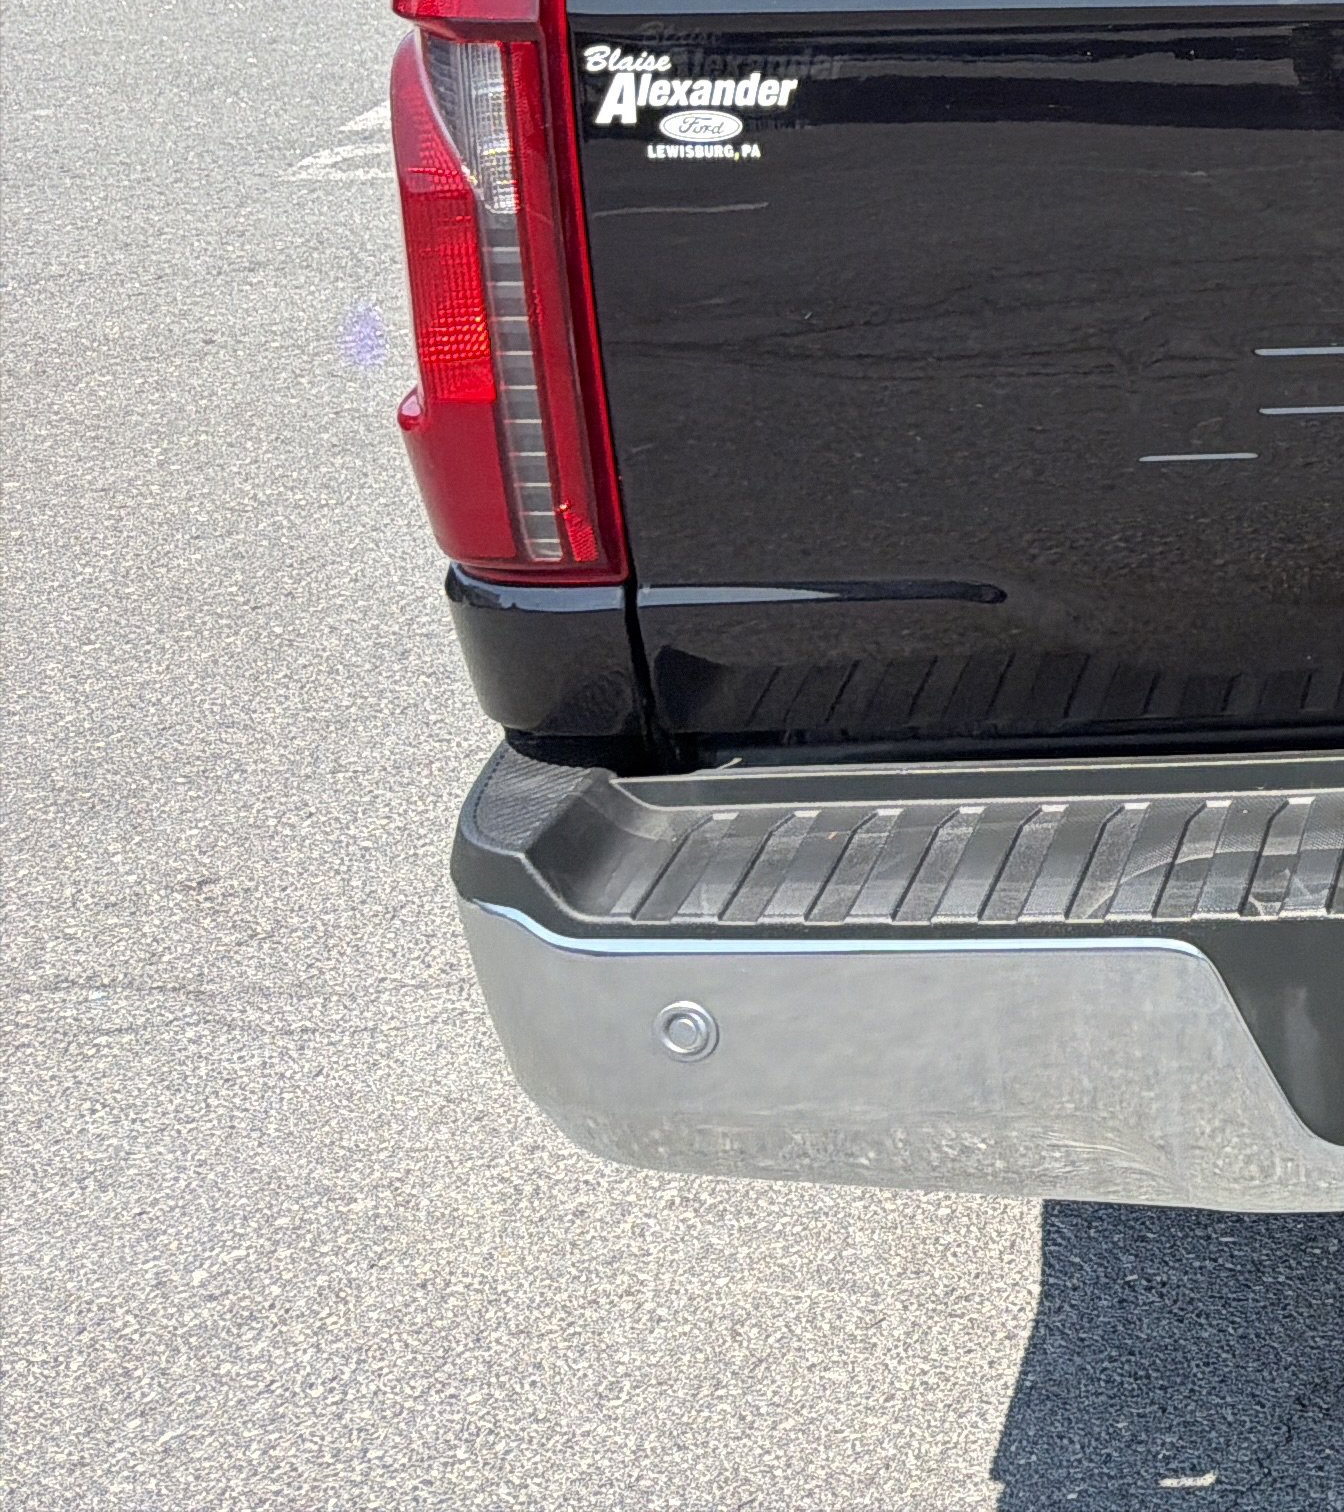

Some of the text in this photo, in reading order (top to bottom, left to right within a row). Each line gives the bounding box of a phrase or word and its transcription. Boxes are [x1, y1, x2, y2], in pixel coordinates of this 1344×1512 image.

[584, 45, 672, 72] Blaise
[595, 72, 798, 125] Alexander
[678, 116, 724, 135] Ford
[647, 144, 761, 161] LEWISBURG, PA
